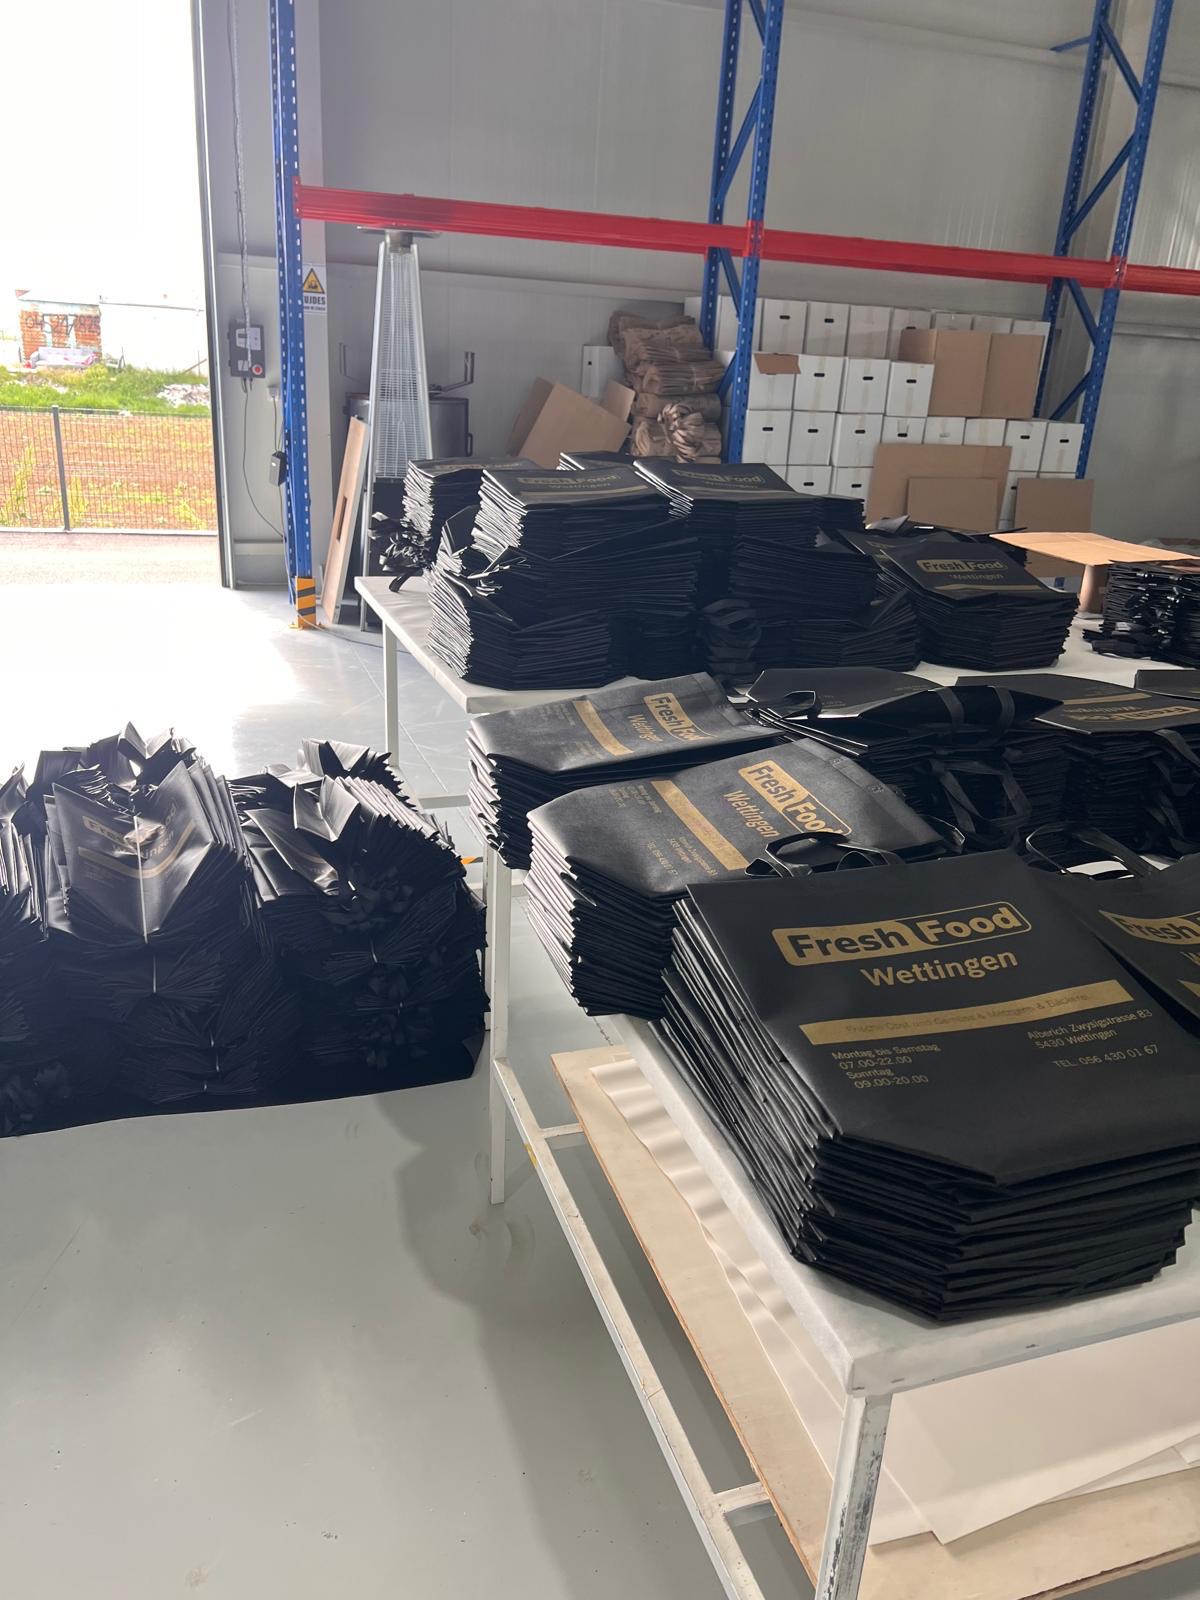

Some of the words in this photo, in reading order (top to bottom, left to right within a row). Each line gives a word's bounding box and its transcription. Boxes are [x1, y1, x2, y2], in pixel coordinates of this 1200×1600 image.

[303, 295, 326, 305] UJDES
[924, 561, 964, 571] Fresh
[966, 561, 1004, 570] Food
[650, 695, 686, 727] Fresh
[747, 765, 798, 803] Fresh
[723, 790, 781, 838] Wettingen
[787, 927, 910, 959] Fresh
[915, 907, 1023, 943] Food
[1111, 916, 1200, 940] Fresh
[859, 950, 1019, 987] Wettingen
[1027, 1025, 1071, 1040] Alberich
[1034, 1038, 1066, 1050] 5430
[1065, 1028, 1119, 1045] Wettingen
[831, 1050, 876, 1060] Montag
[893, 1044, 942, 1055] Samstag
[1078, 1055, 1103, 1066] 056
[1103, 1050, 1127, 1063] 430
[1126, 1047, 1144, 1059] 01
[1143, 1043, 1160, 1056] 67
[846, 1068, 895, 1079] Sonntag
